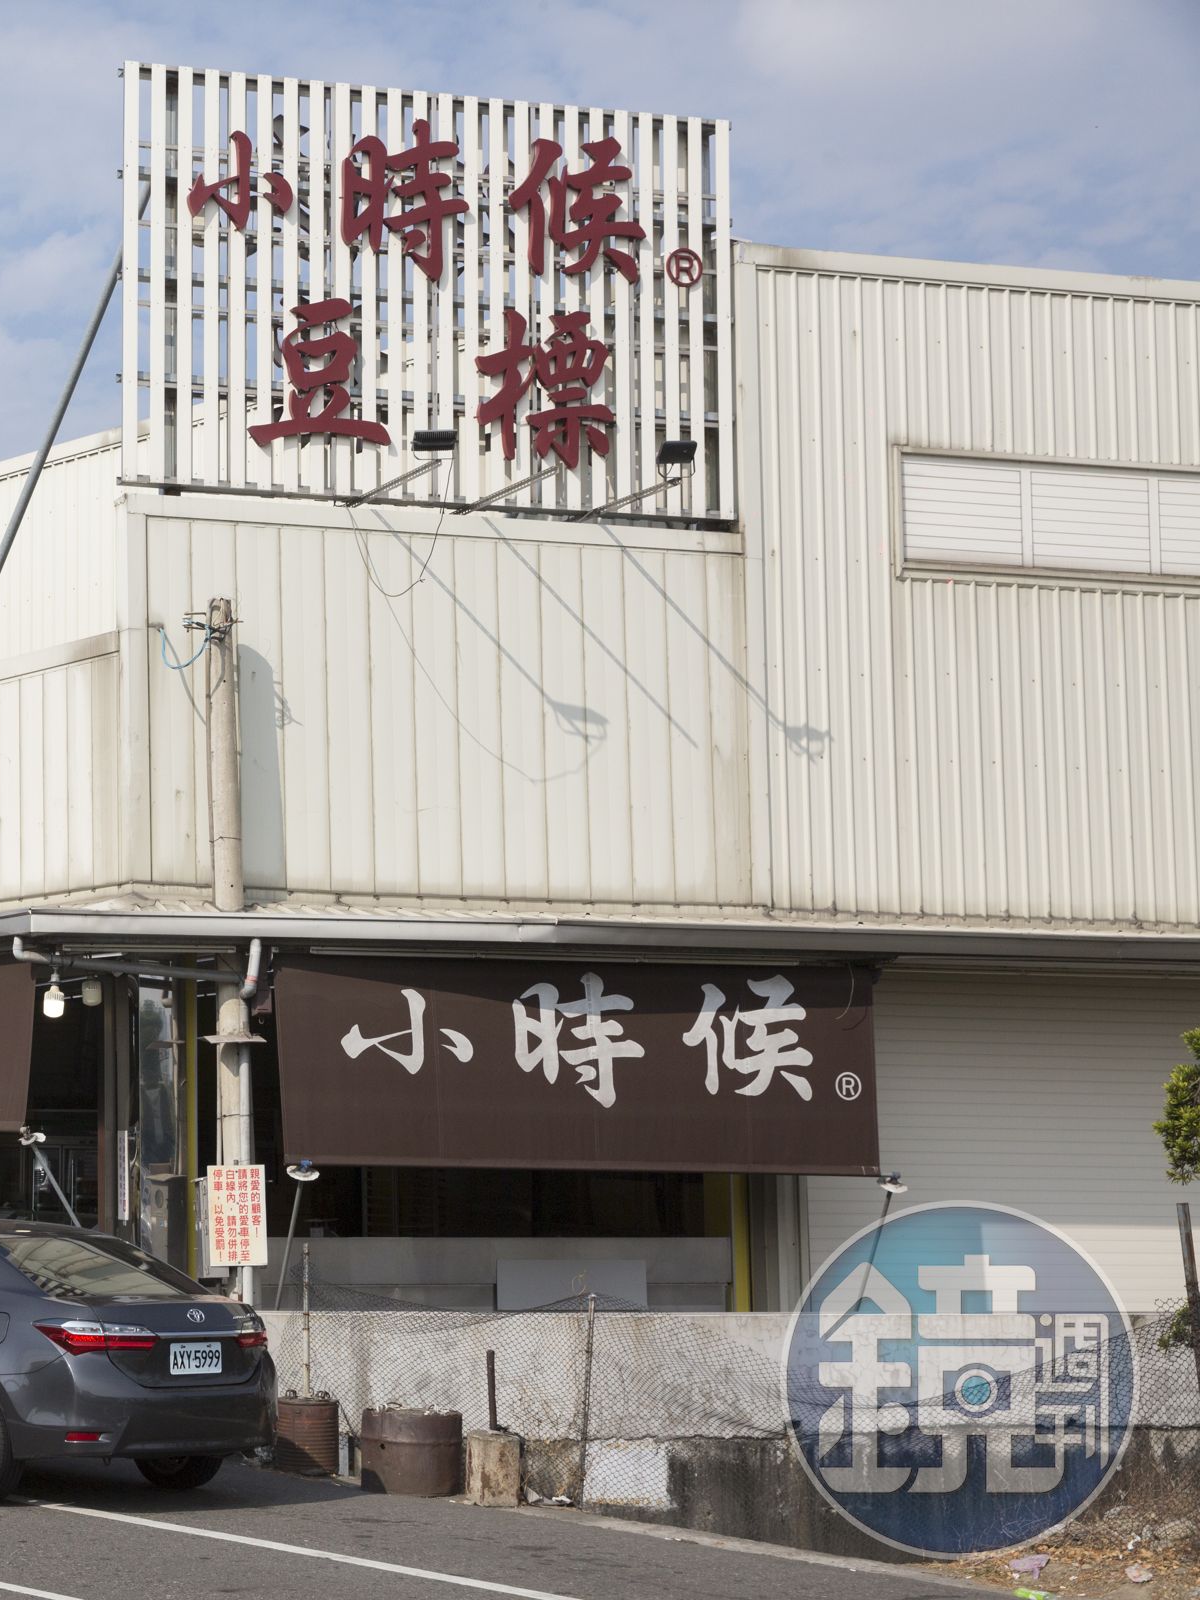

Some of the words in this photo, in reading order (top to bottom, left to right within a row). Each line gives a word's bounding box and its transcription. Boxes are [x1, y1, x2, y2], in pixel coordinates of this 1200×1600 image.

[187, 118, 646, 284] 小時候
[341, 972, 813, 1108] 小時候
[237, 1168, 250, 1262] 請將您的愛車停至
